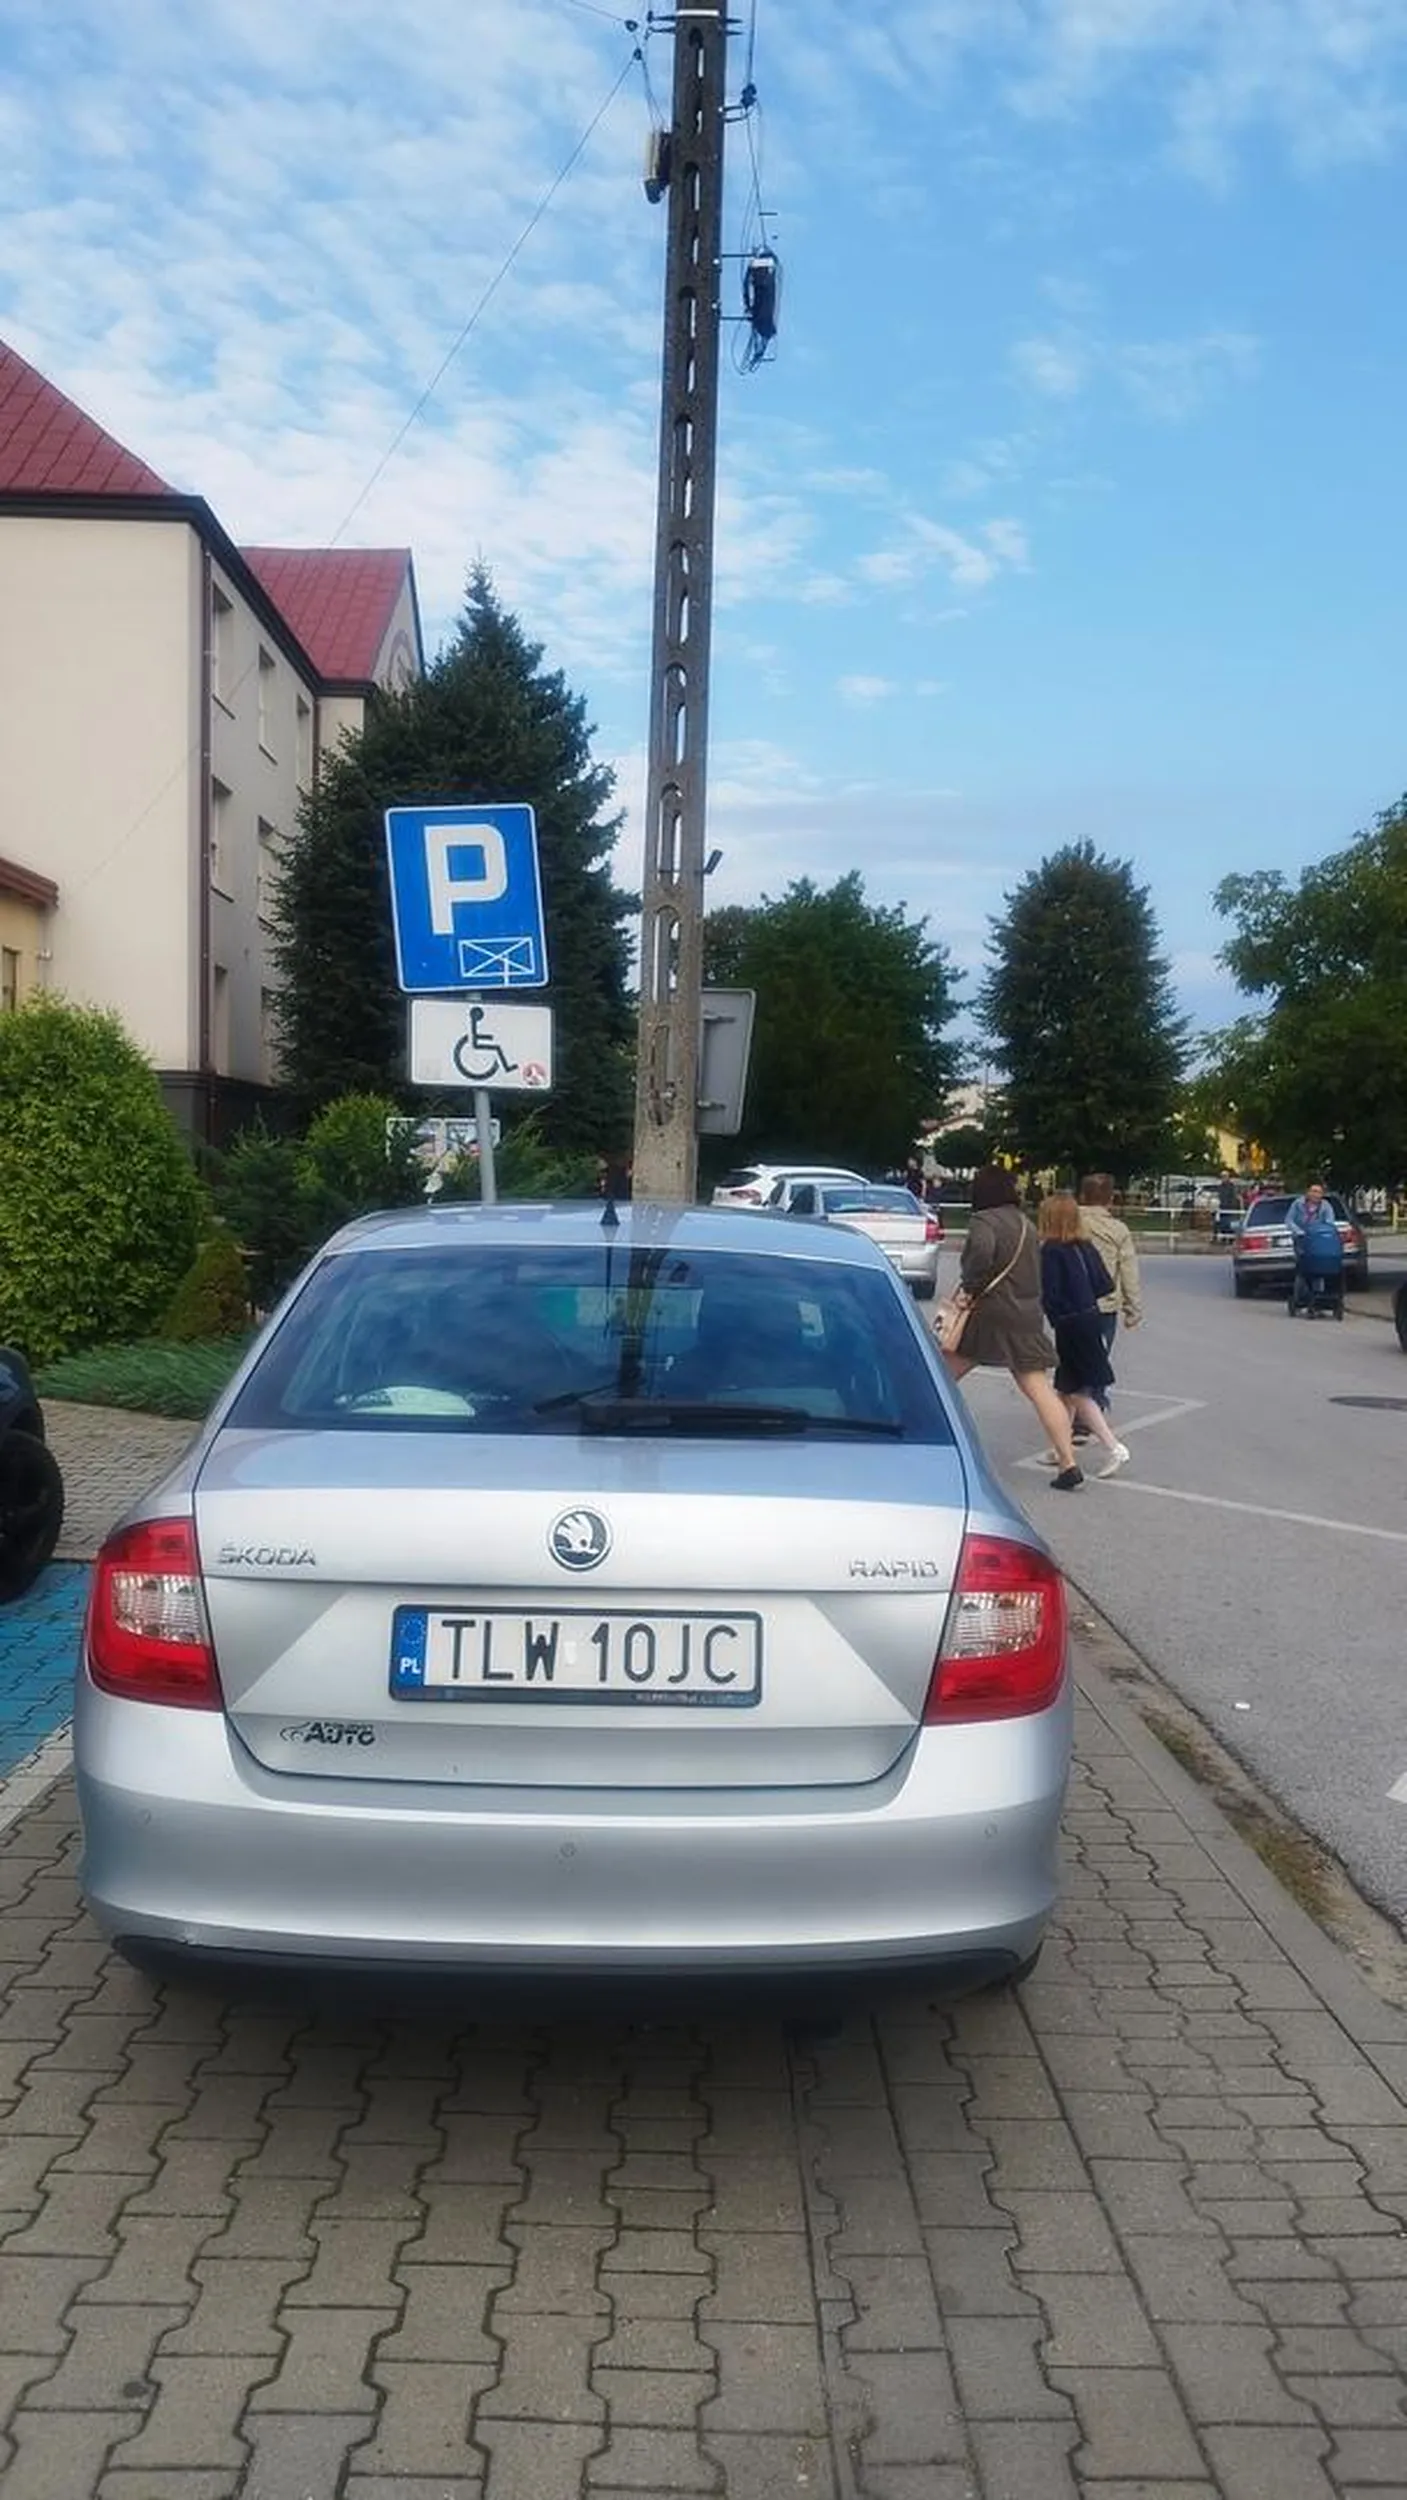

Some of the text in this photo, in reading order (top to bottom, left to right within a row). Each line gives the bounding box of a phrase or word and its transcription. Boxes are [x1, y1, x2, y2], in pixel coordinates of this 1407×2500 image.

[424, 824, 508, 935] P
[848, 1559, 939, 1578] RAPID
[401, 1657, 421, 1674] PL
[441, 1619, 738, 1685] TLW 10JC
